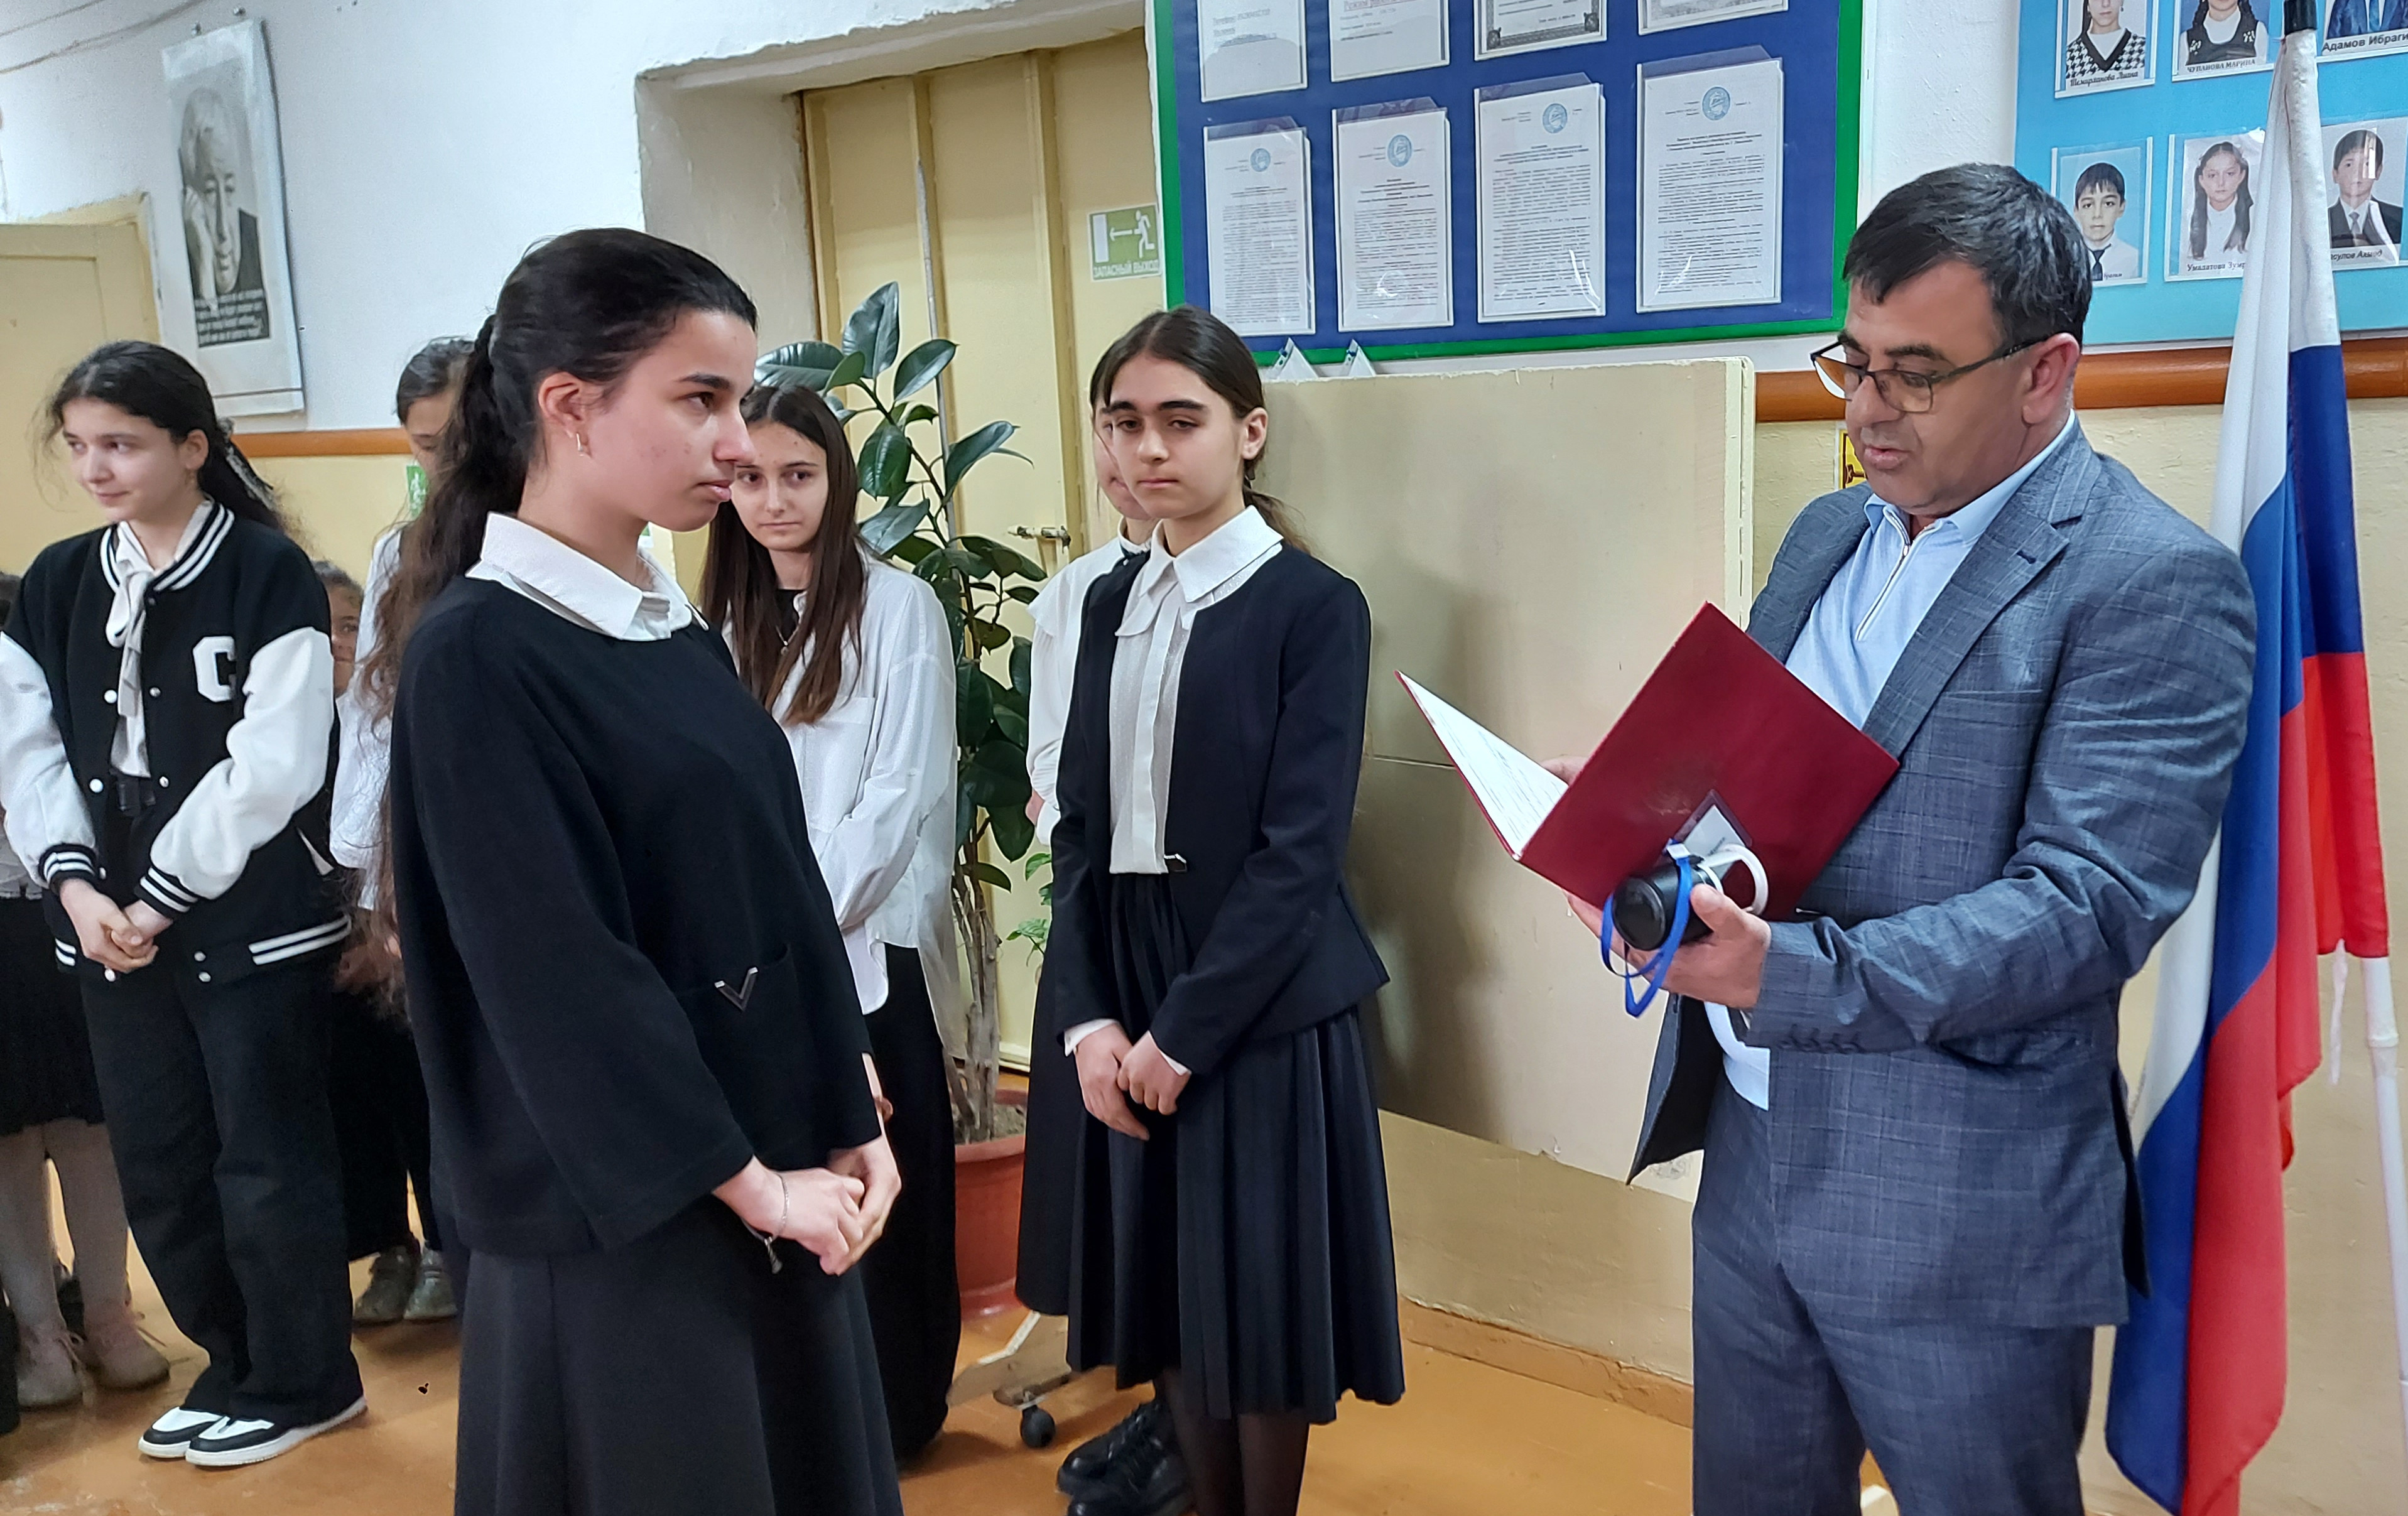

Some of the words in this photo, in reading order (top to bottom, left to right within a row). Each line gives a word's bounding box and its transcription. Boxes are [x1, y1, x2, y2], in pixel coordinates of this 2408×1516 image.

[2322, 39, 2366, 52] Адамов
[2225, 59, 2255, 68] МАРИНА
[1093, 260, 1131, 278] ЗАПАСНЫЙ
[1132, 259, 1159, 274] ВЫХОД
[192, 636, 237, 703] C
